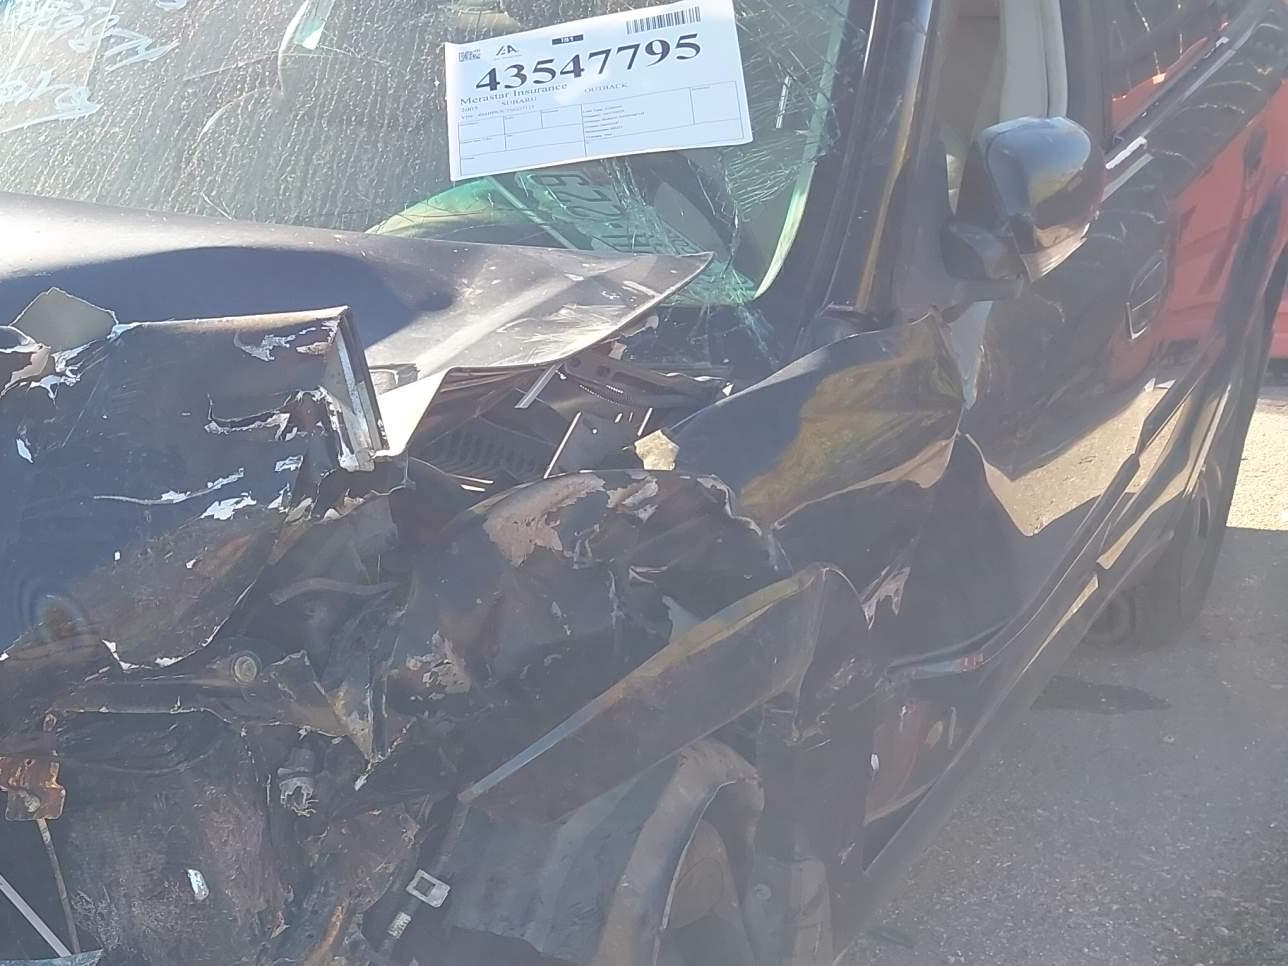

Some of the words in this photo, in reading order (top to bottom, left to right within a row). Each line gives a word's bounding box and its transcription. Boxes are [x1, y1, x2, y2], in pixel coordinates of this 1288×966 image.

[476, 33, 701, 92] 43547795
[460, 87, 510, 105] Merastar
[512, 83, 568, 98] Insurance
